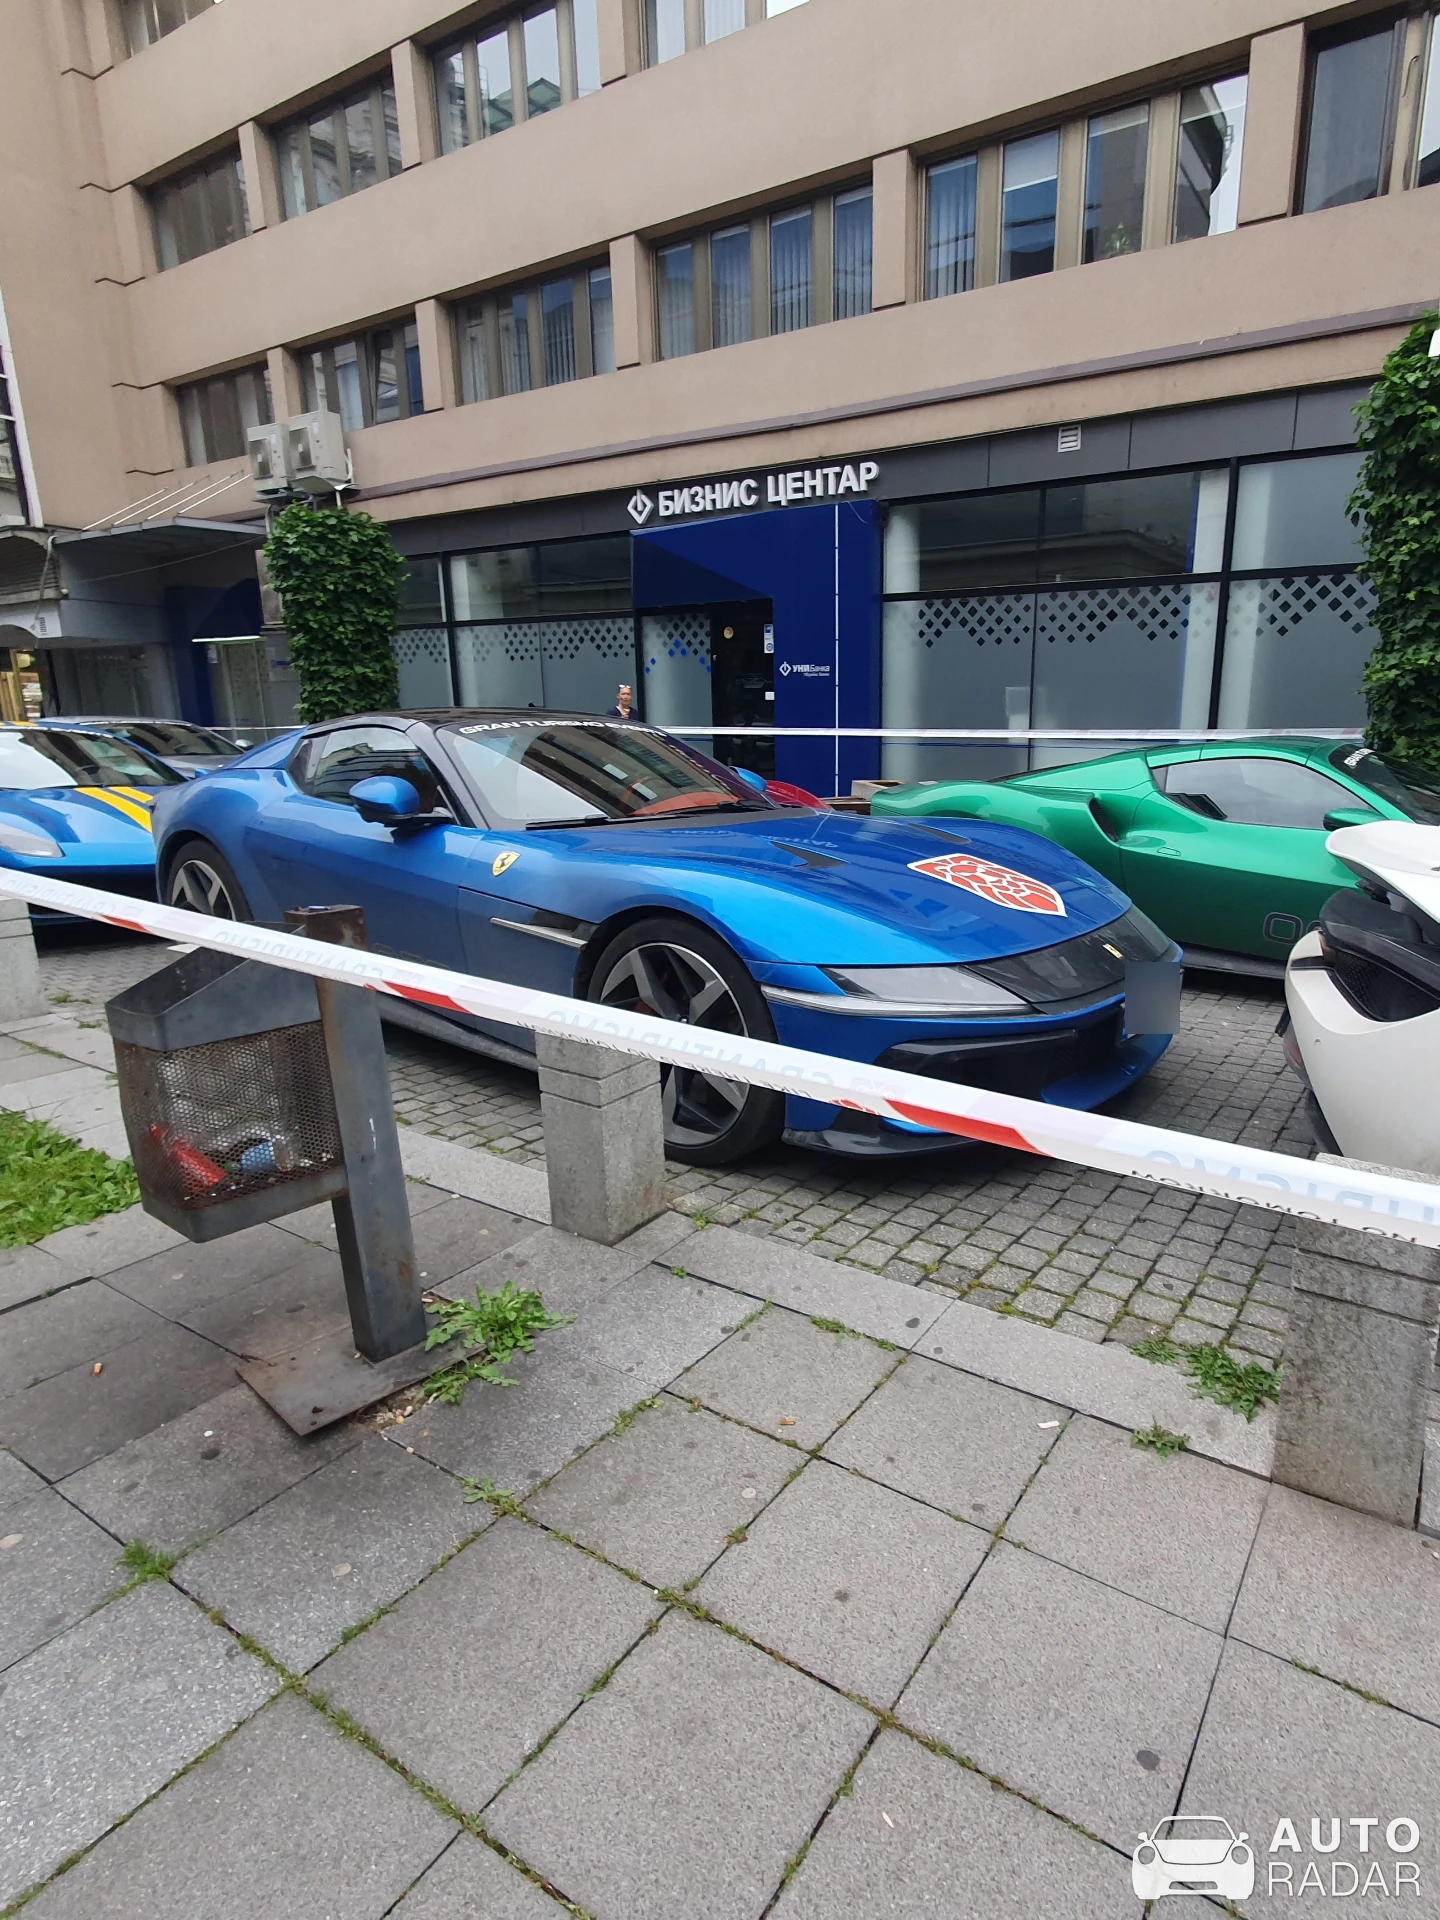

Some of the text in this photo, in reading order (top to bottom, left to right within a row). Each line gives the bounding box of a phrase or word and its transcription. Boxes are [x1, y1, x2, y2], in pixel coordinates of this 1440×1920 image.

[658, 461, 880, 517] БИЗНИС ЦЕНТАР
[459, 721, 521, 734] GRAN
